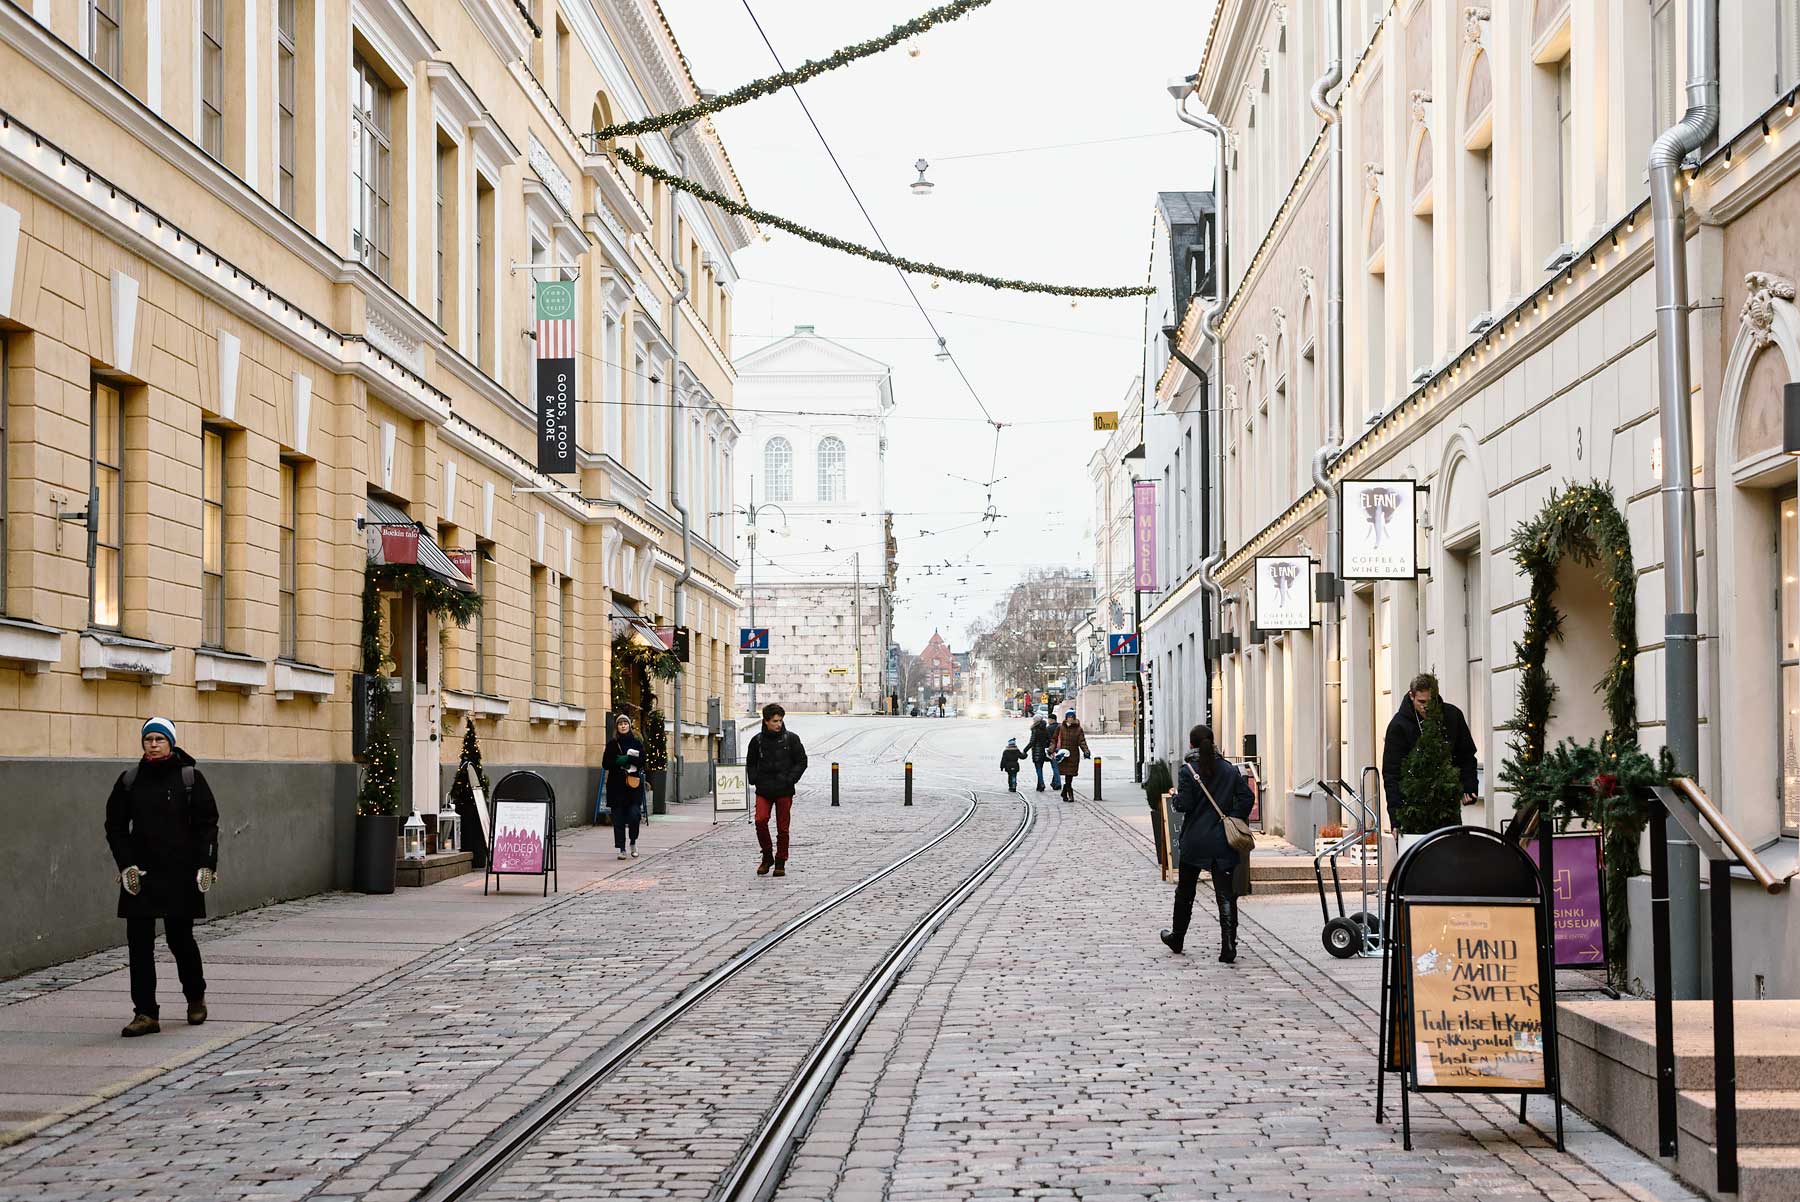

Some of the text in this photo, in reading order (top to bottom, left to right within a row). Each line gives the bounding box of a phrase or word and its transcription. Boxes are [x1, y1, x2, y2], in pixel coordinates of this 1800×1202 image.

[546, 395, 556, 442] & MORE
[557, 373, 568, 459] GOODS, FOOD
[1577, 426, 1583, 461] 3
[1361, 493, 1397, 509] EL FANT
[1140, 515, 1153, 587] MUSEO
[1352, 556, 1393, 564] COFFEE
[1269, 565, 1297, 578] EL FANT
[1553, 908, 1584, 918] SINKI
[1457, 937, 1517, 960] HAND
[1452, 962, 1518, 982] MADE
